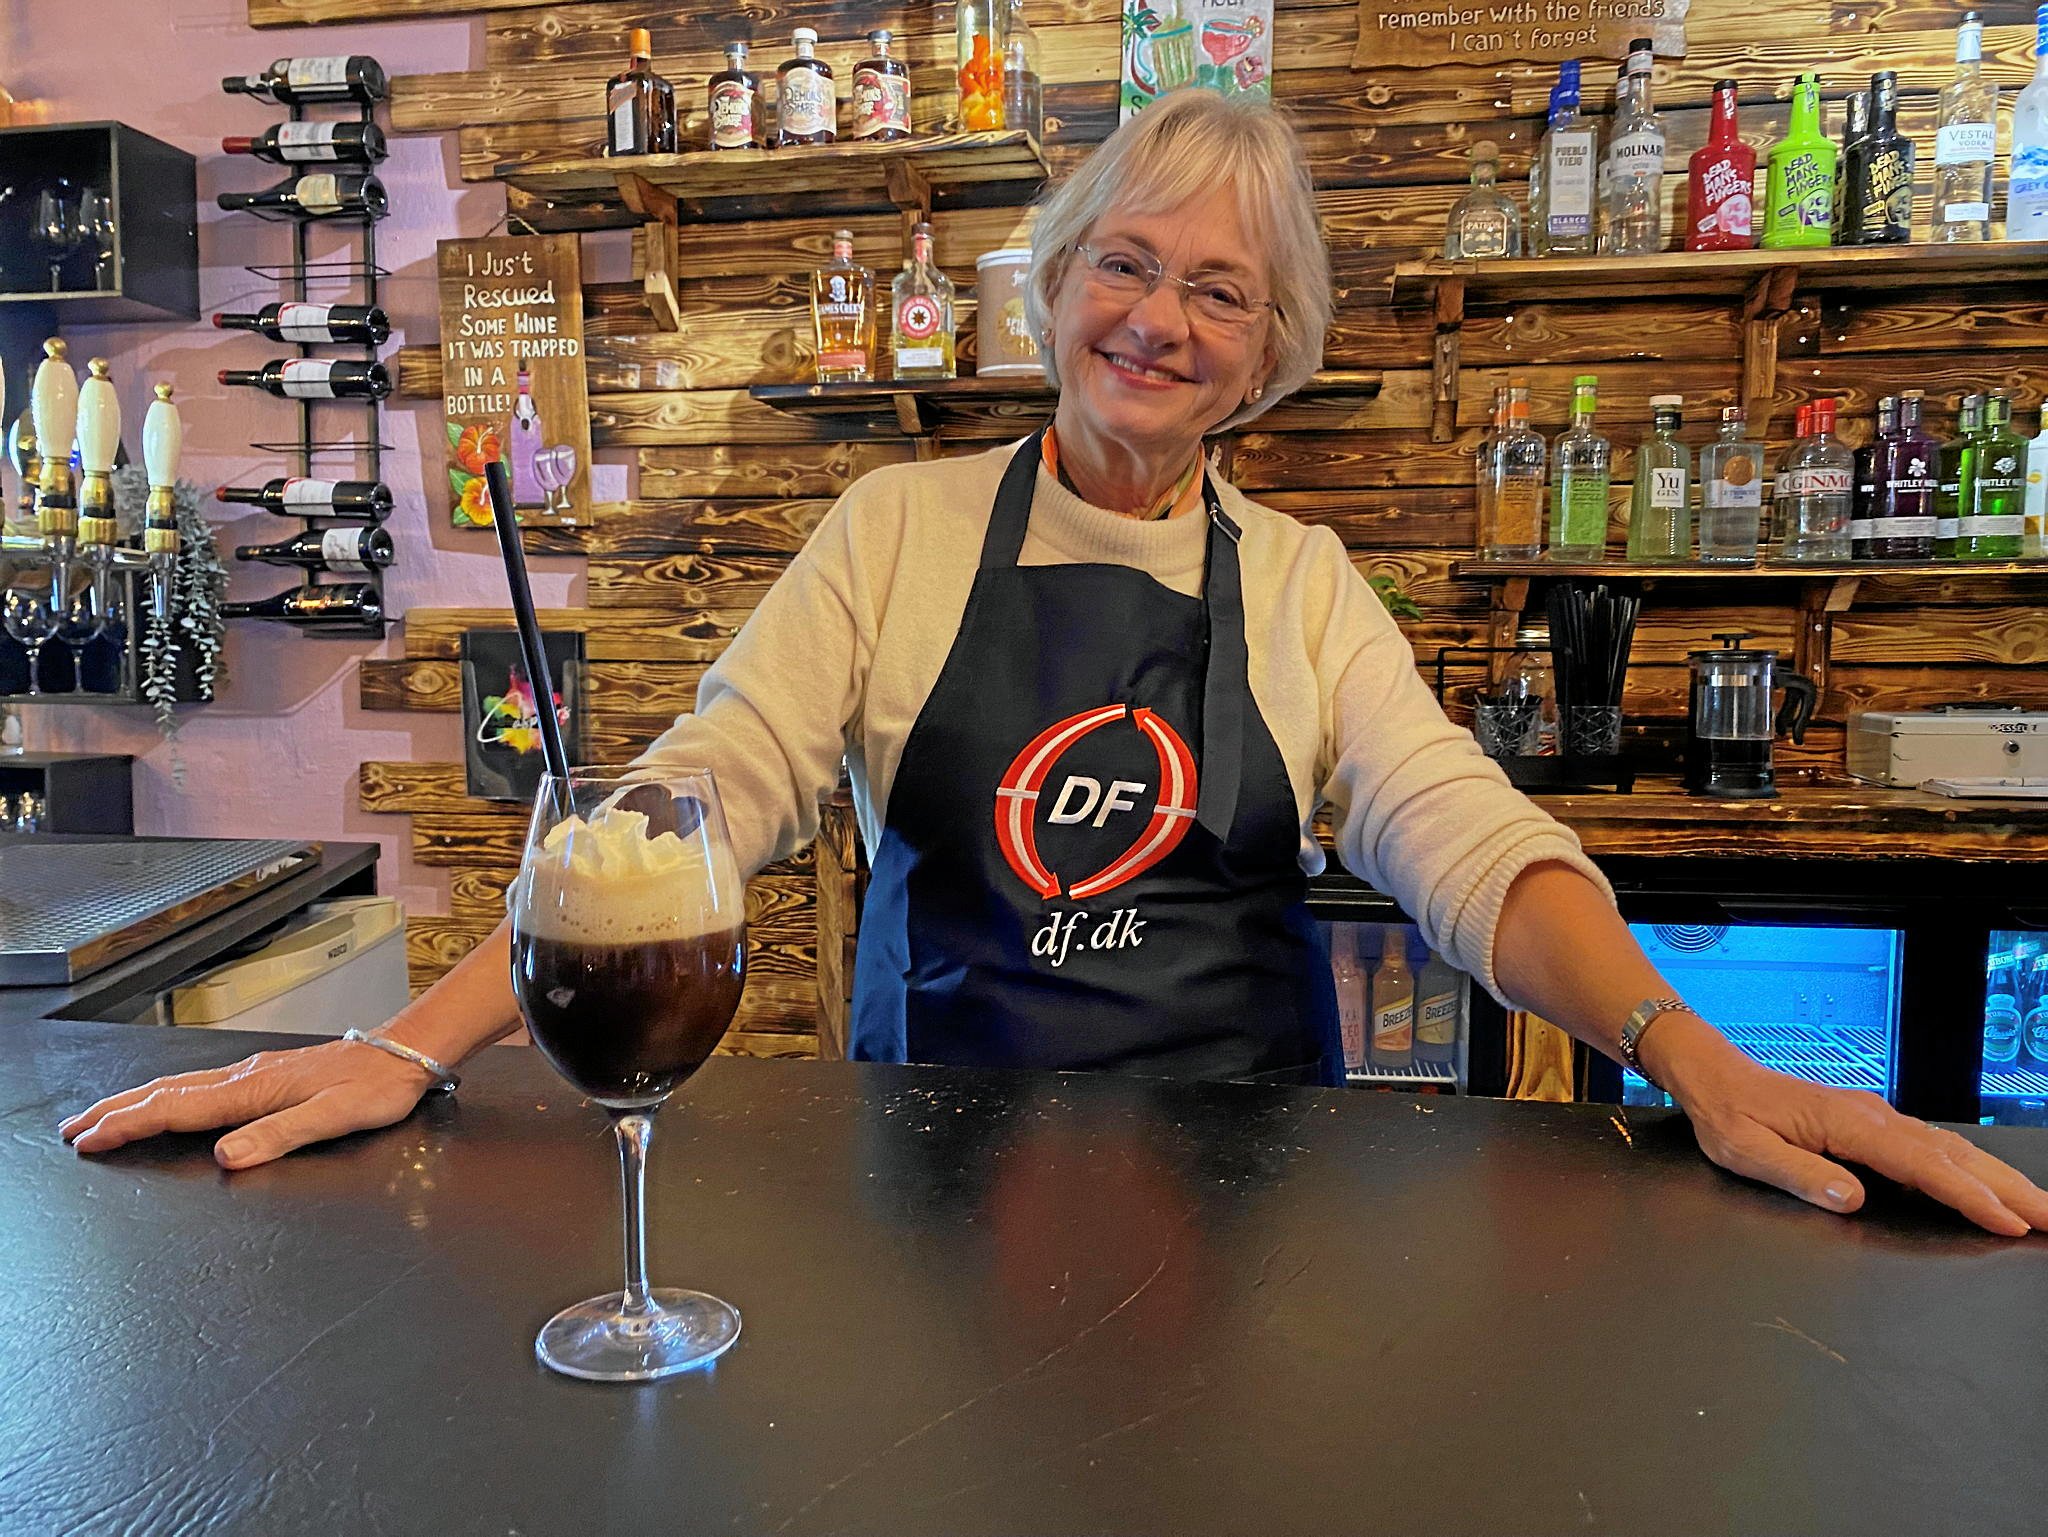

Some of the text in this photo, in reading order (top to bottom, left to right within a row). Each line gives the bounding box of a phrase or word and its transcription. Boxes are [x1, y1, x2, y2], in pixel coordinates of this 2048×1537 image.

[1378, 0, 1665, 30] remember with the friends
[1450, 23, 1597, 51] I can't forget
[1949, 130, 1994, 141] VESTAL
[1558, 156, 1583, 167] VIEJO
[1702, 159, 1731, 185] DEAD
[1784, 153, 1813, 177] DEAD
[1869, 150, 1900, 176] DEAD
[1706, 180, 1752, 207] FINGERS
[1552, 216, 1587, 225] BLANCO
[467, 253, 474, 277] I
[464, 279, 556, 309] Rescued
[514, 312, 558, 335] WINE
[448, 338, 579, 360] IT WAS TRAPPED
[464, 366, 506, 387] IN A
[447, 394, 511, 416] BOTTLE!
[1656, 472, 1680, 489] Yu
[1886, 479, 1923, 488] WHITLEY
[1656, 489, 1680, 497] GIN
[1048, 775, 1147, 828] DF
[1031, 908, 1147, 968] df.dk
